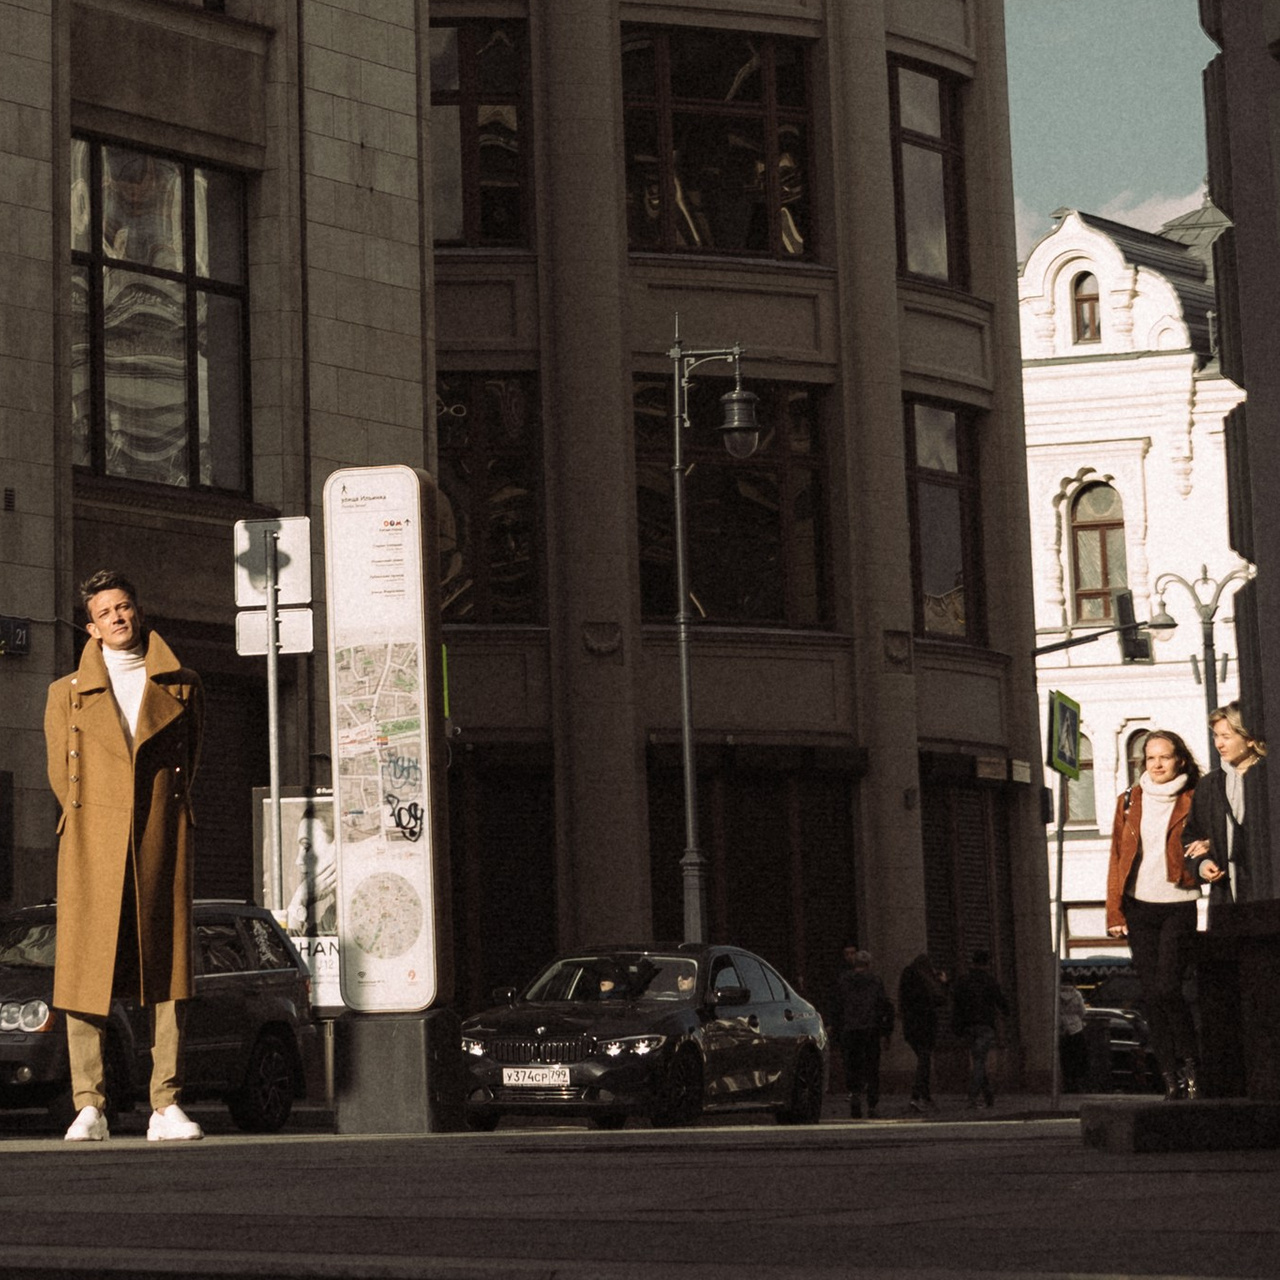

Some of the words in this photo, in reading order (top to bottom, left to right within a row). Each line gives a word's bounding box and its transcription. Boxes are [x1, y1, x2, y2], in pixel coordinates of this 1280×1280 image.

[15, 628, 27, 645] 21
[507, 1070, 548, 1082] У374СР
[550, 1070, 567, 1079] 799
